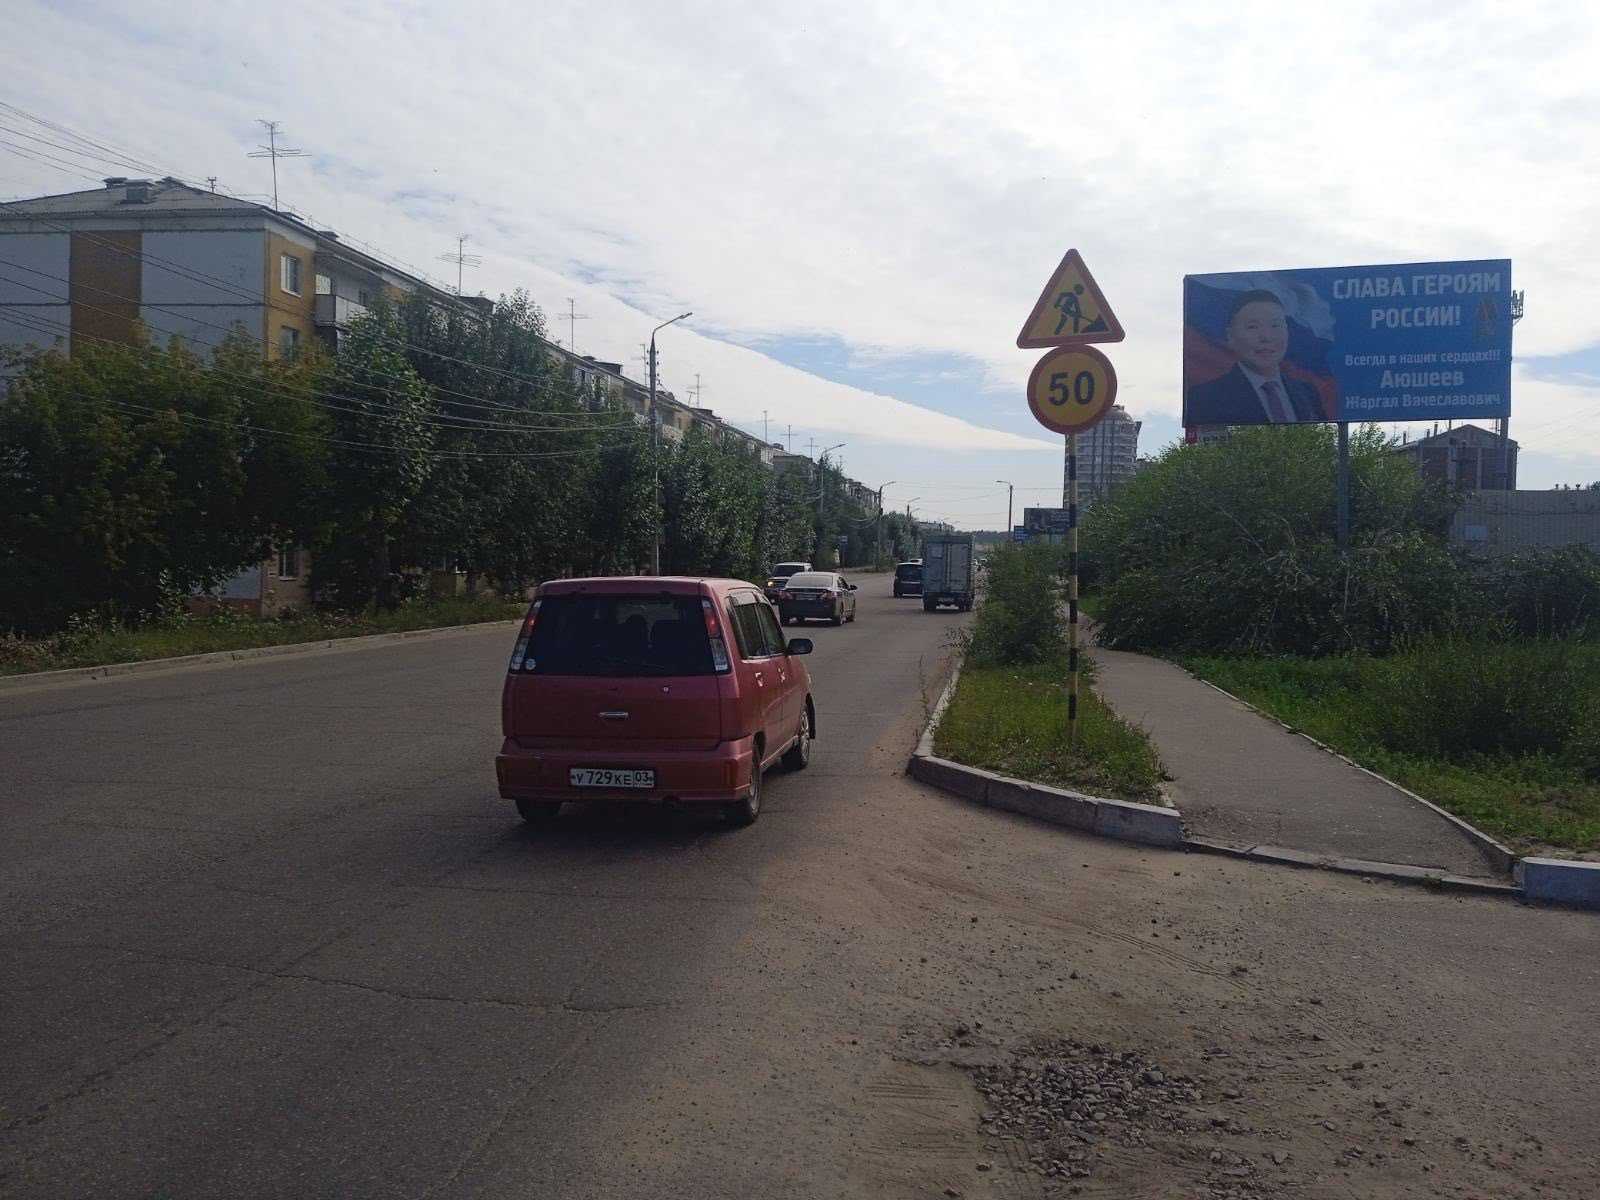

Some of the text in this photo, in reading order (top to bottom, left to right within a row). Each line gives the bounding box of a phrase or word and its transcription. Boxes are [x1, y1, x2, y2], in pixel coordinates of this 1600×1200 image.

[1333, 273, 1500, 299] СЛАВА ГЕРОЯМ
[1370, 305, 1461, 329] РОССИИ!
[1345, 354, 1386, 366] Всегда
[1388, 355, 1398, 365] в
[1400, 353, 1436, 364] наших
[1048, 370, 1095, 406] 50
[1380, 370, 1464, 389] Аюшеев
[1345, 395, 1399, 410] Жаргал
